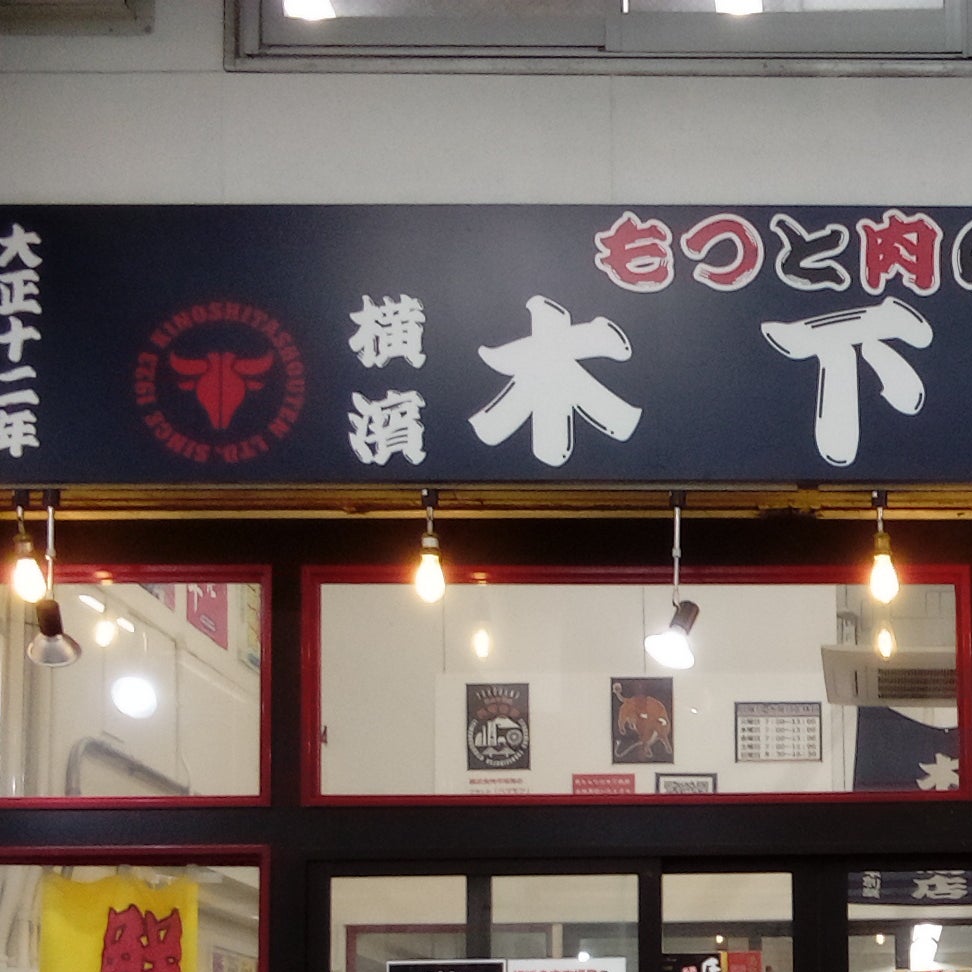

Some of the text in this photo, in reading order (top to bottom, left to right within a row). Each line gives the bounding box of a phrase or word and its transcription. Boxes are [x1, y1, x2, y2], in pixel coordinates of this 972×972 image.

[0, 223, 42, 458] 大正十二年
[348, 293, 427, 466] 横濱
